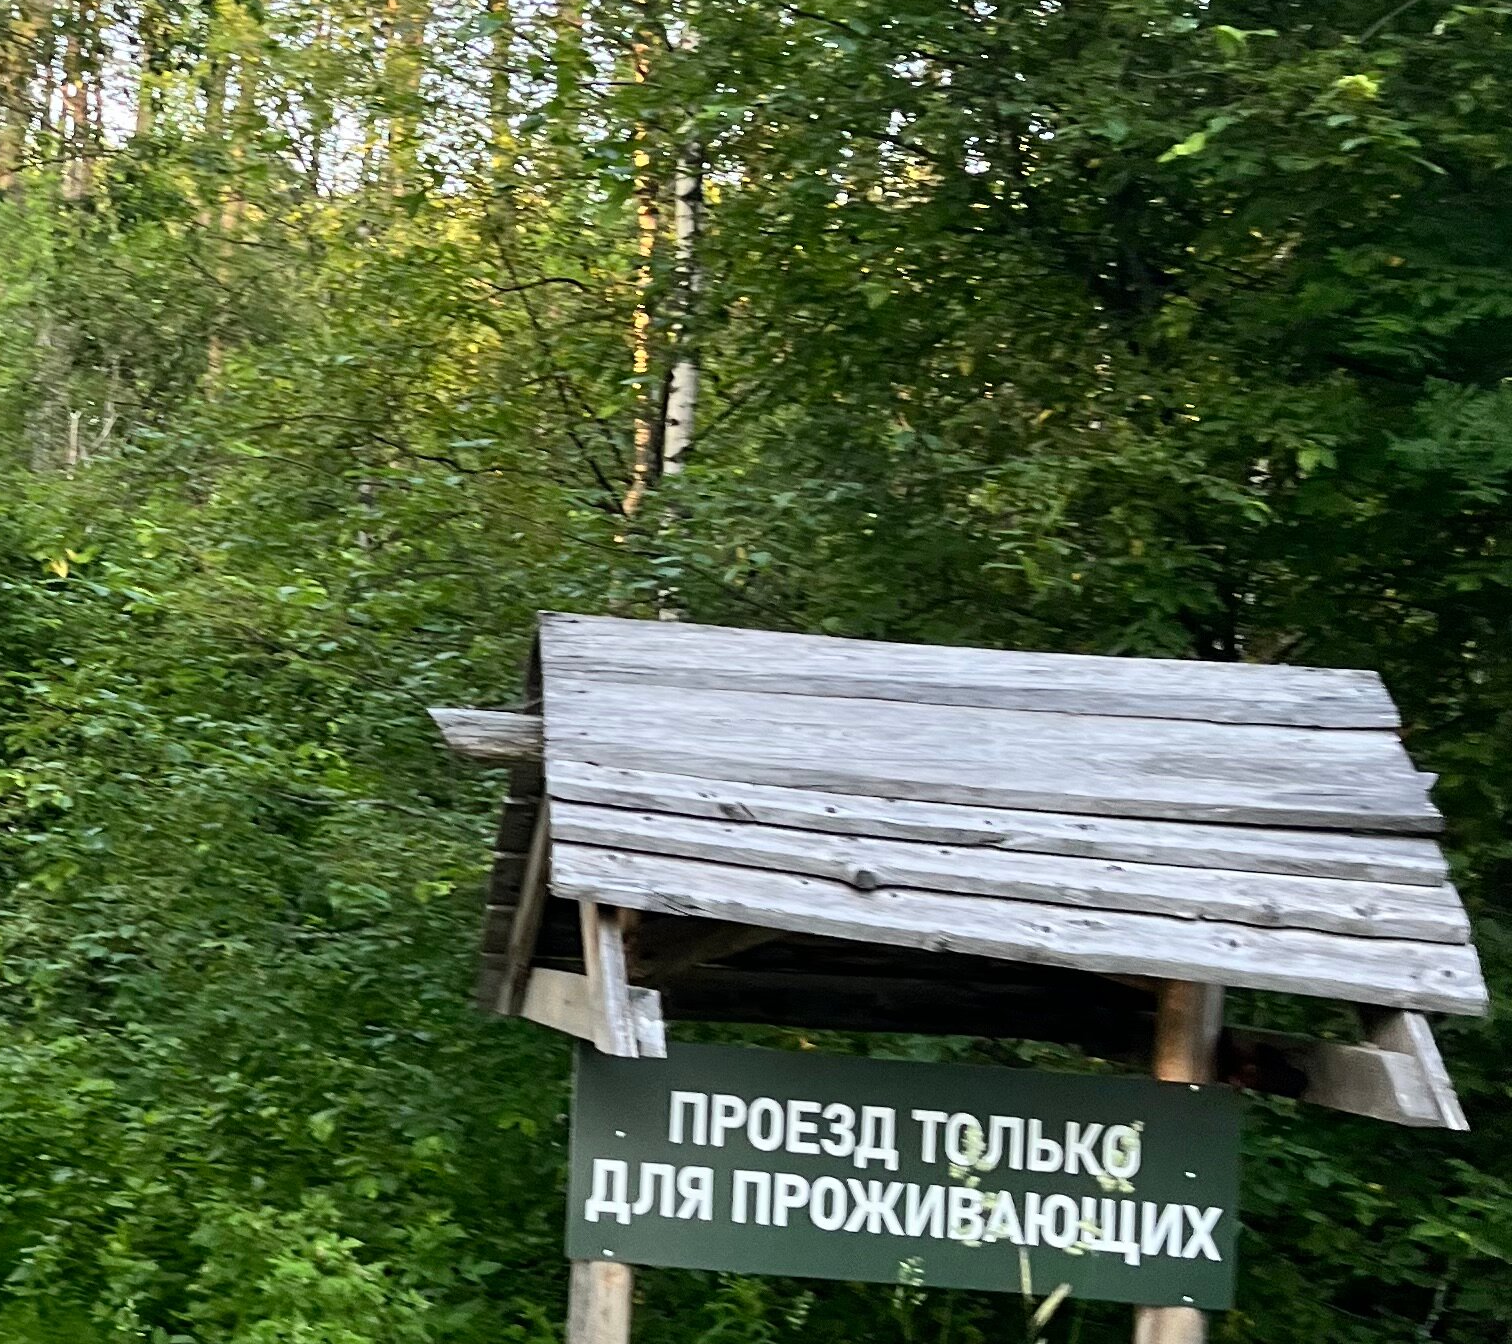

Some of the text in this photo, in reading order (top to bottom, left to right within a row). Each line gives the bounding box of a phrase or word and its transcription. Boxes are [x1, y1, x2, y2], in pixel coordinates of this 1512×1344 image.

[668, 1090, 1142, 1179] ПРОЕЗД ТОЛЬКО
[584, 1158, 1223, 1264] ДЛЯ ПРОЖИВАЮЩИХ
